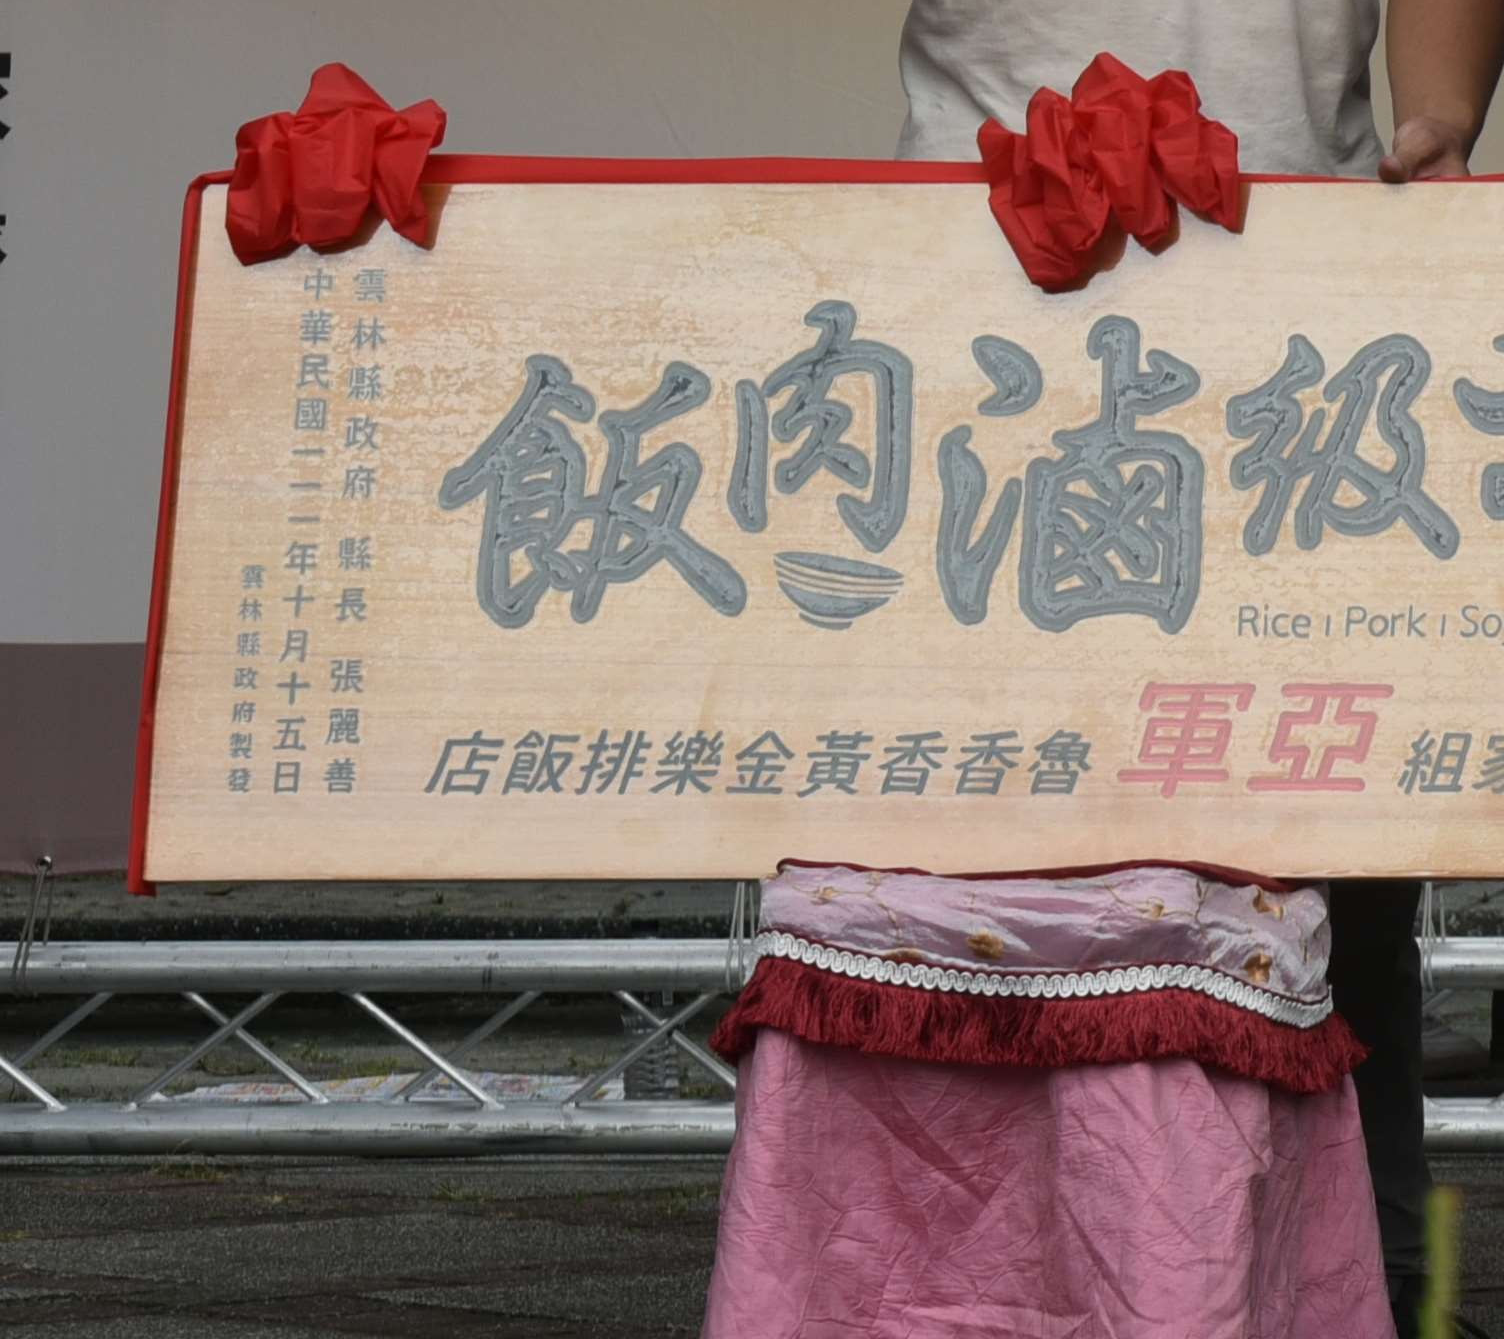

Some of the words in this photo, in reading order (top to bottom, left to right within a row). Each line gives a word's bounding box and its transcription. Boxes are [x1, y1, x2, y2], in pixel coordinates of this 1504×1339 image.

[341, 267, 389, 501] 雲林縣政府
[272, 266, 337, 795] 中華民國一一一年十月十五日
[334, 535, 374, 623] 縣長
[1237, 604, 1311, 639] Rice
[1344, 603, 1426, 639] Pork
[227, 563, 267, 793] 雲林縣政府製發
[322, 658, 364, 795] 張麗善
